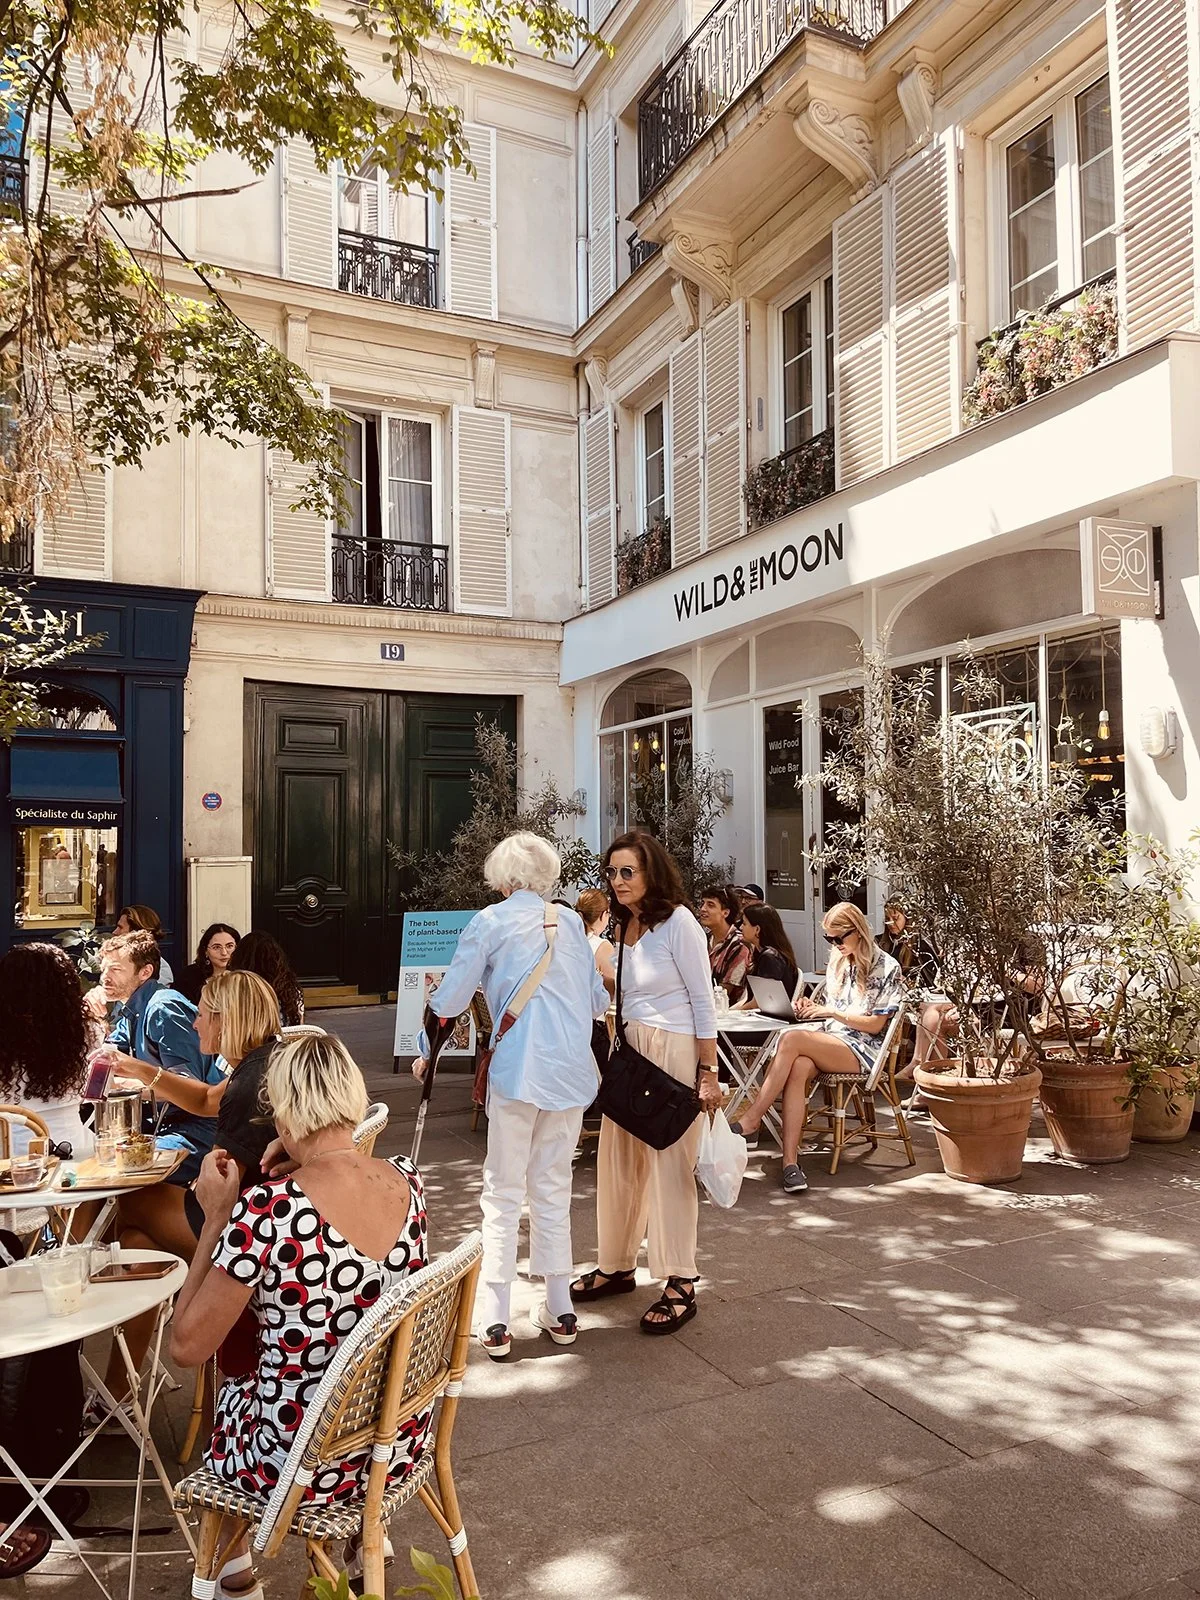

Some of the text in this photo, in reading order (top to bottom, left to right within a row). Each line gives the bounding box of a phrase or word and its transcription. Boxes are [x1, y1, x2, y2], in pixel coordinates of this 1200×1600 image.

[749, 558, 758, 594] THE
[759, 522, 844, 591] MOON
[385, 644, 400, 659] 19
[673, 726, 685, 736] Cold
[768, 737, 800, 751] Wild Food
[768, 762, 800, 775] Juice Bar
[15, 807, 118, 822] Spécialiste du Saphir
[416, 928, 458, 937] plant-based
